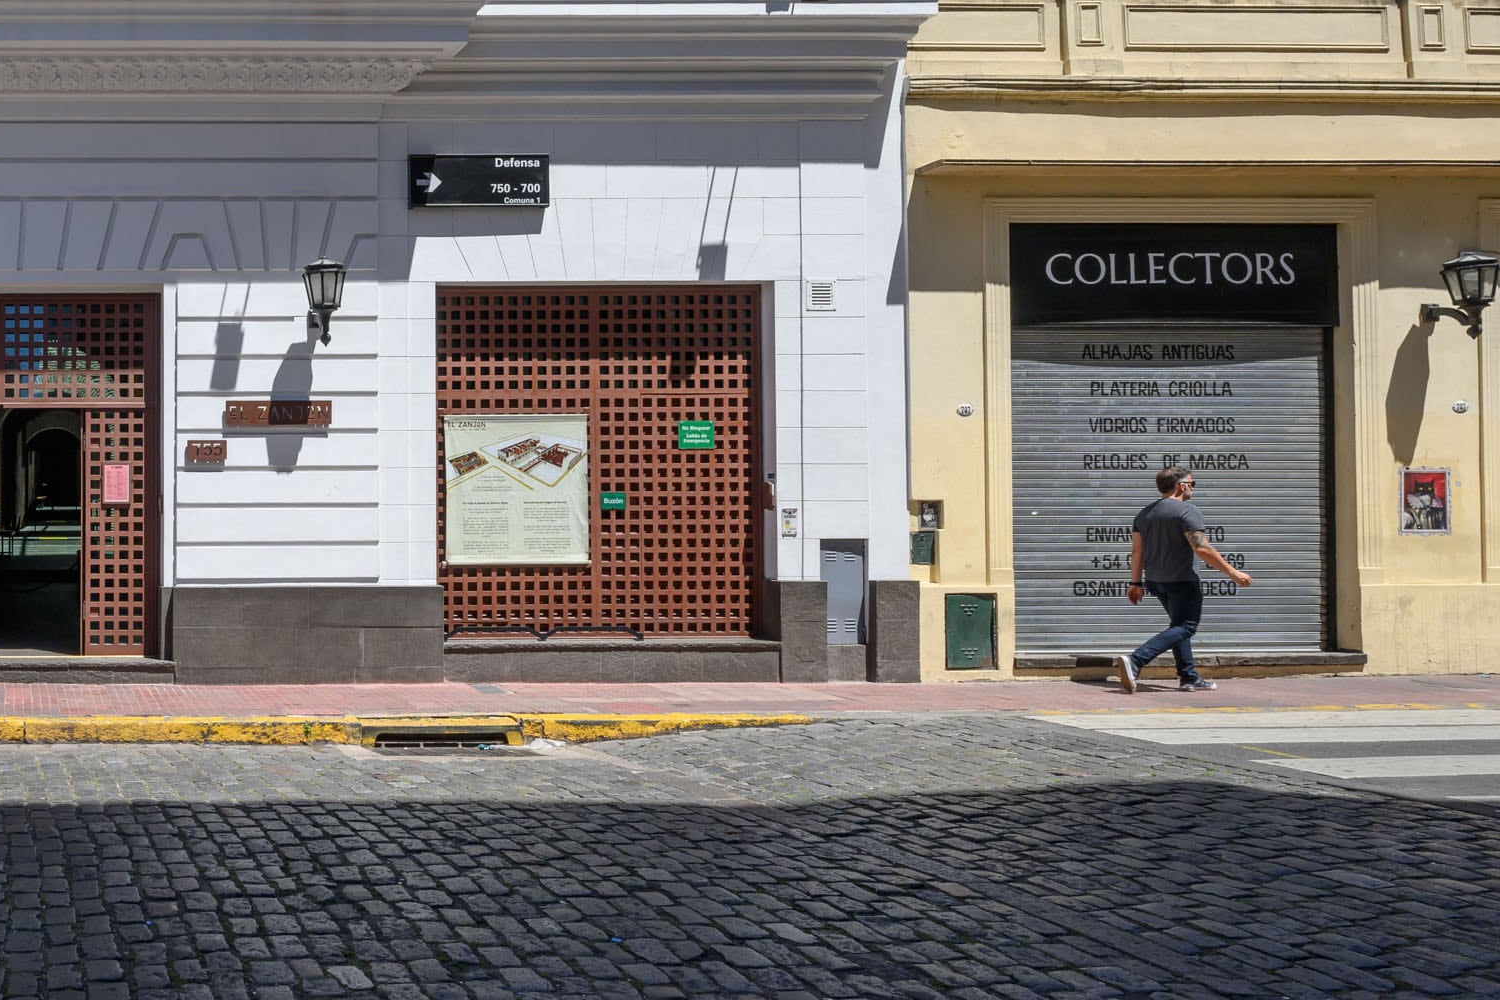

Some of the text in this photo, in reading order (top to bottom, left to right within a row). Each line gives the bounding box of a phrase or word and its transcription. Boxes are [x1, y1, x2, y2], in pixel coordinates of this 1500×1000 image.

[495, 157, 540, 168] Defensa
[490, 184, 510, 193] 750
[520, 184, 540, 193] 700
[1045, 252, 1296, 285] COLLECTORS
[1082, 344, 1235, 361] ALHAJAS ANTIGUAS
[1090, 380, 1233, 397] PLATERIA CRIOLLA
[229, 405, 248, 420] EL
[1089, 417, 1236, 434] VIDRIOS FIRMADOS
[192, 443, 223, 457] 755
[1083, 453, 1250, 470] RELOJES DE MARCA
[1091, 554, 1122, 570] +54
